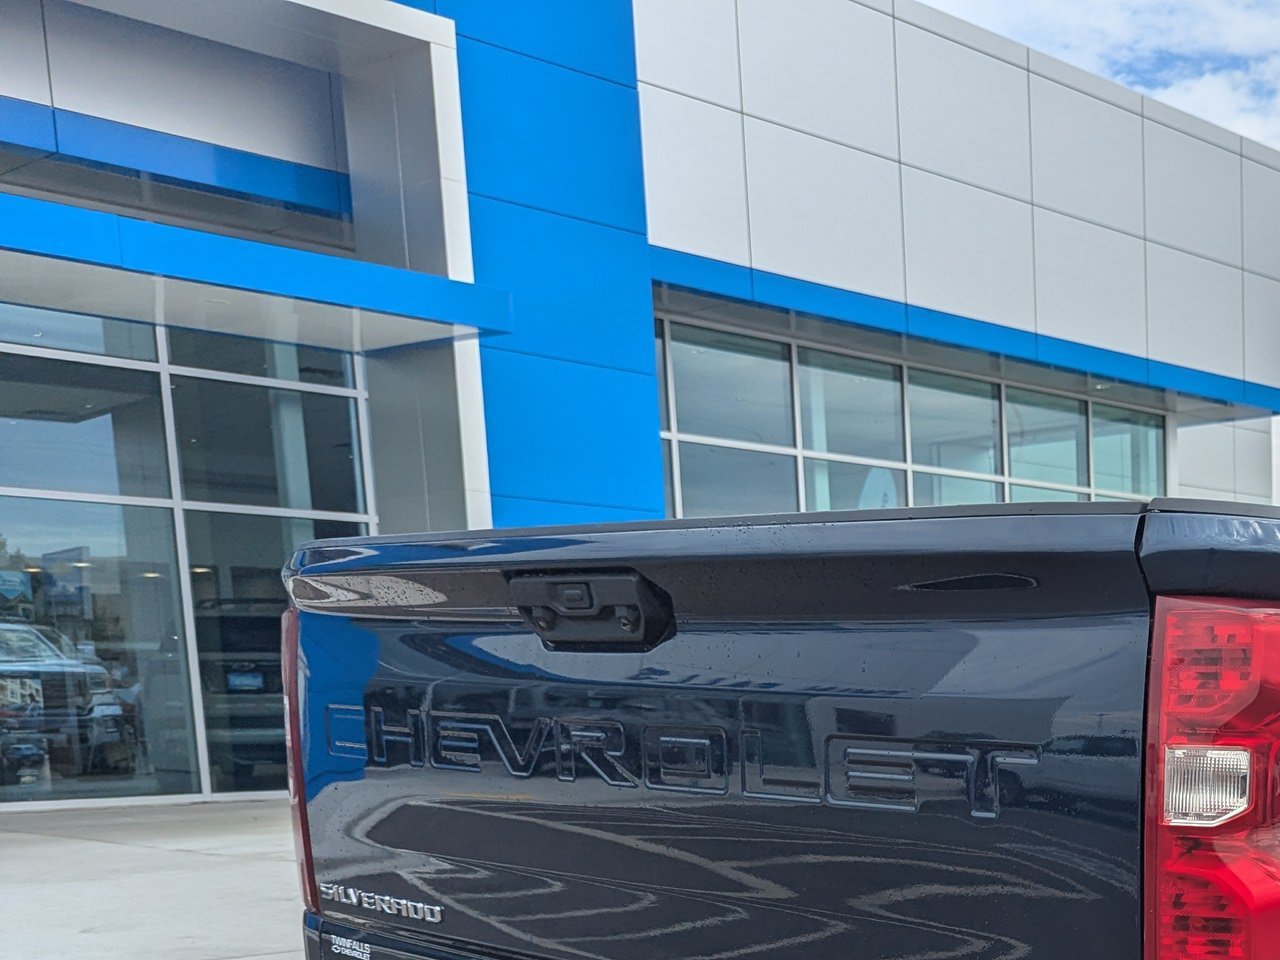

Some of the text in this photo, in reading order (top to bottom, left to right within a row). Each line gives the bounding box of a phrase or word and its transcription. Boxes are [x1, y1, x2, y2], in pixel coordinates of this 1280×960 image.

[326, 703, 1043, 818] CHEVROLET
[319, 882, 443, 924] SILVERADO
[340, 947, 371, 960] CHEVROLET
